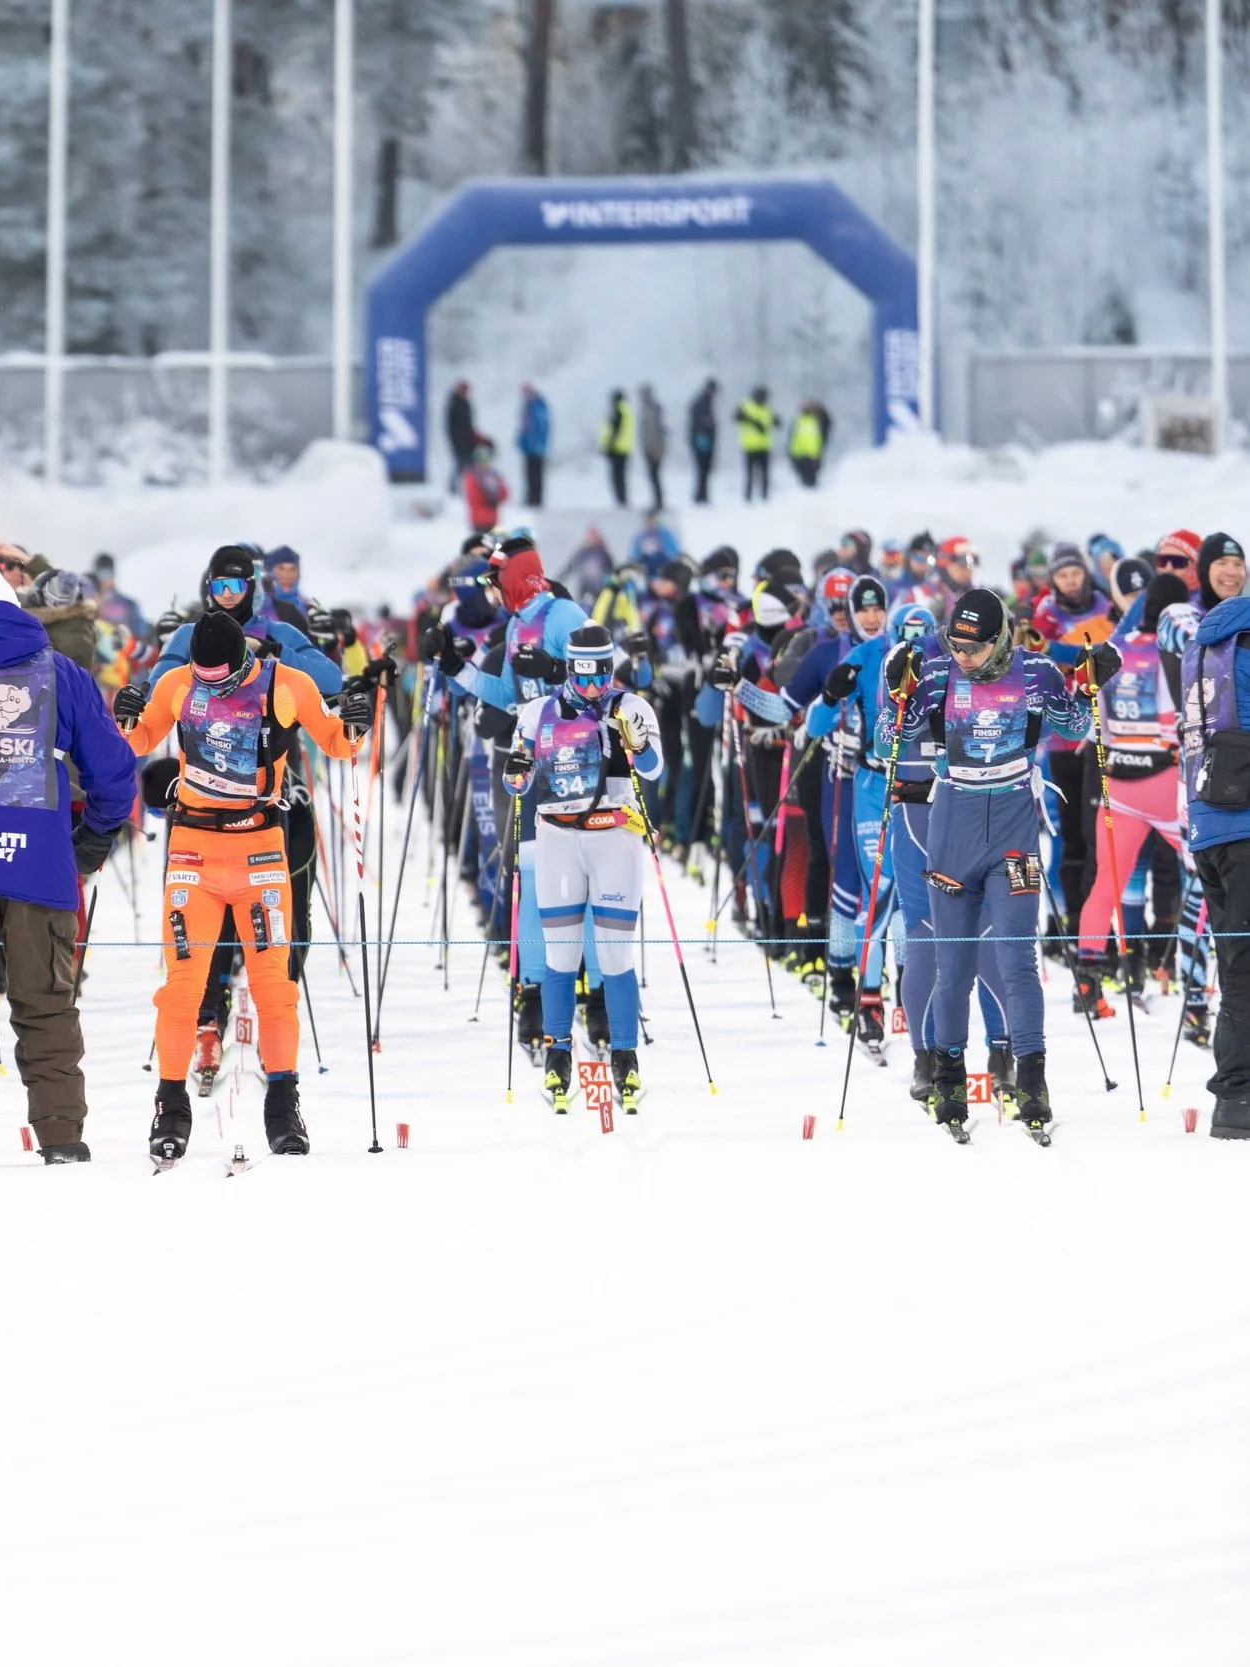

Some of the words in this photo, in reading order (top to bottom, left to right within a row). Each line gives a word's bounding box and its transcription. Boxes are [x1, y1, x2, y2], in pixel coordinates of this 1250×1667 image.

[955, 622, 978, 634] GRK
[523, 680, 538, 698] 62
[1115, 700, 1140, 719] 93
[973, 729, 1002, 737] FINSKI
[206, 737, 232, 750] FINSKI
[980, 743, 996, 763] 7
[214, 751, 228, 773] 5
[554, 763, 580, 772] FINSKI
[555, 775, 586, 798] 34
[588, 815, 615, 825] COXA
[629, 819, 644, 829] COXA
[237, 1020, 251, 1041] 61
[580, 1065, 606, 1082] 34
[587, 1085, 612, 1102] 20
[967, 1077, 988, 1099] 21
[602, 1107, 611, 1128] 6
